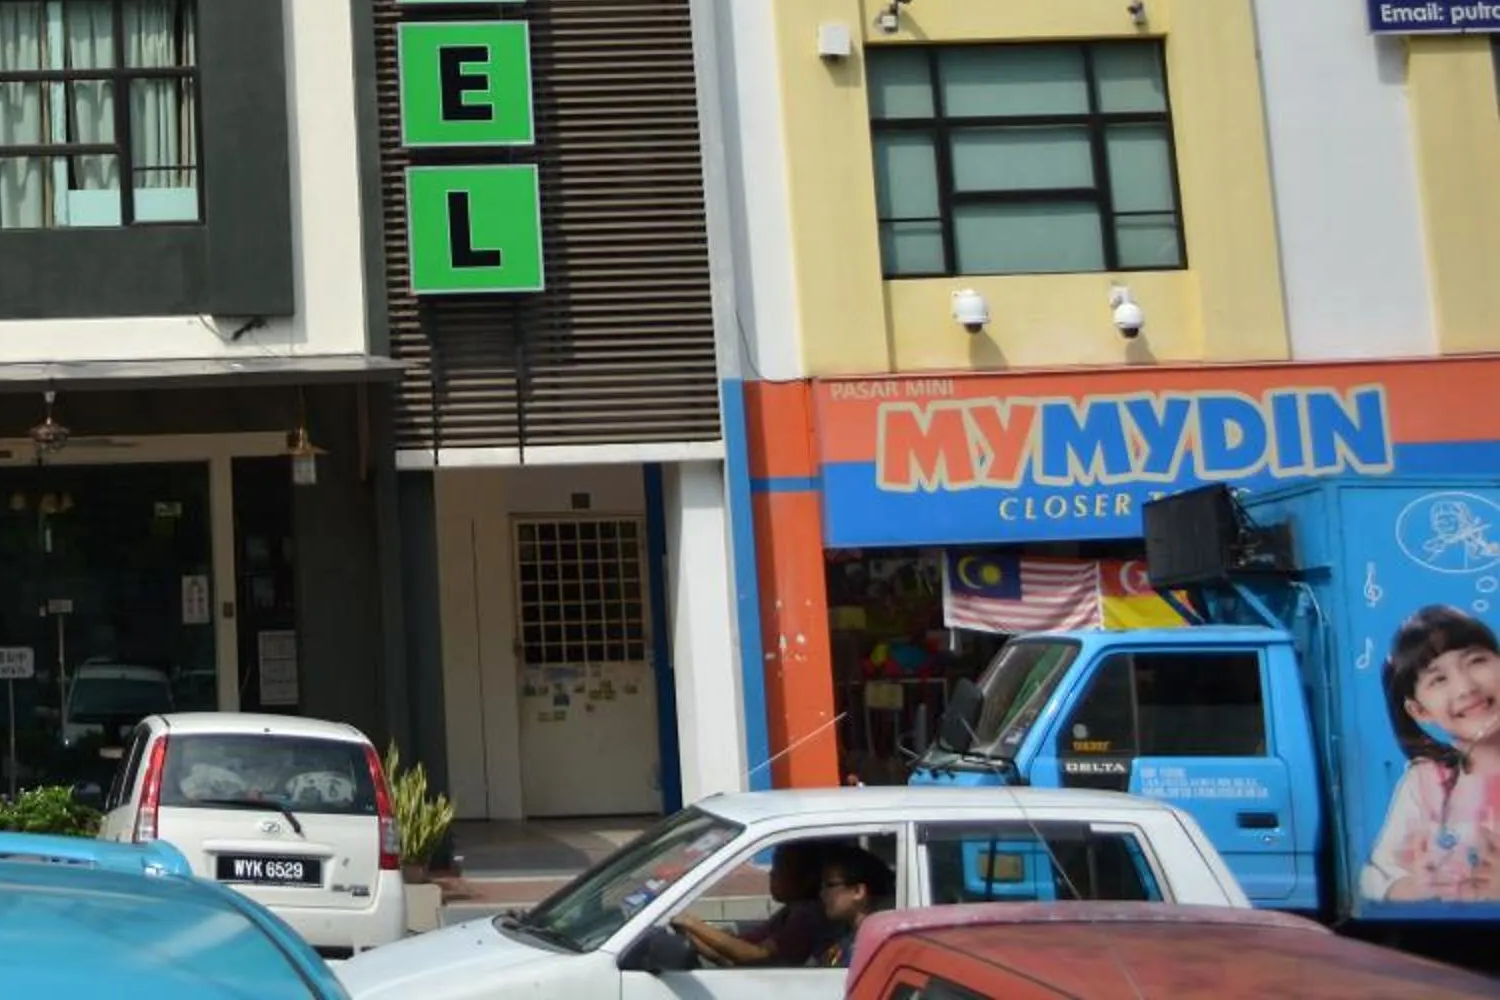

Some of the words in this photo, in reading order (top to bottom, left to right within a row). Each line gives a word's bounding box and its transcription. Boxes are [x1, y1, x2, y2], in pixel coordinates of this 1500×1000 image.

[1380, 4, 1444, 23] Email:
[830, 381, 898, 399] PASAR
[905, 379, 954, 396] MINI
[998, 494, 1132, 520] CLOSER
[1065, 762, 1126, 774] DELTA
[233, 859, 263, 877] WYK
[265, 861, 303, 879] 6529
